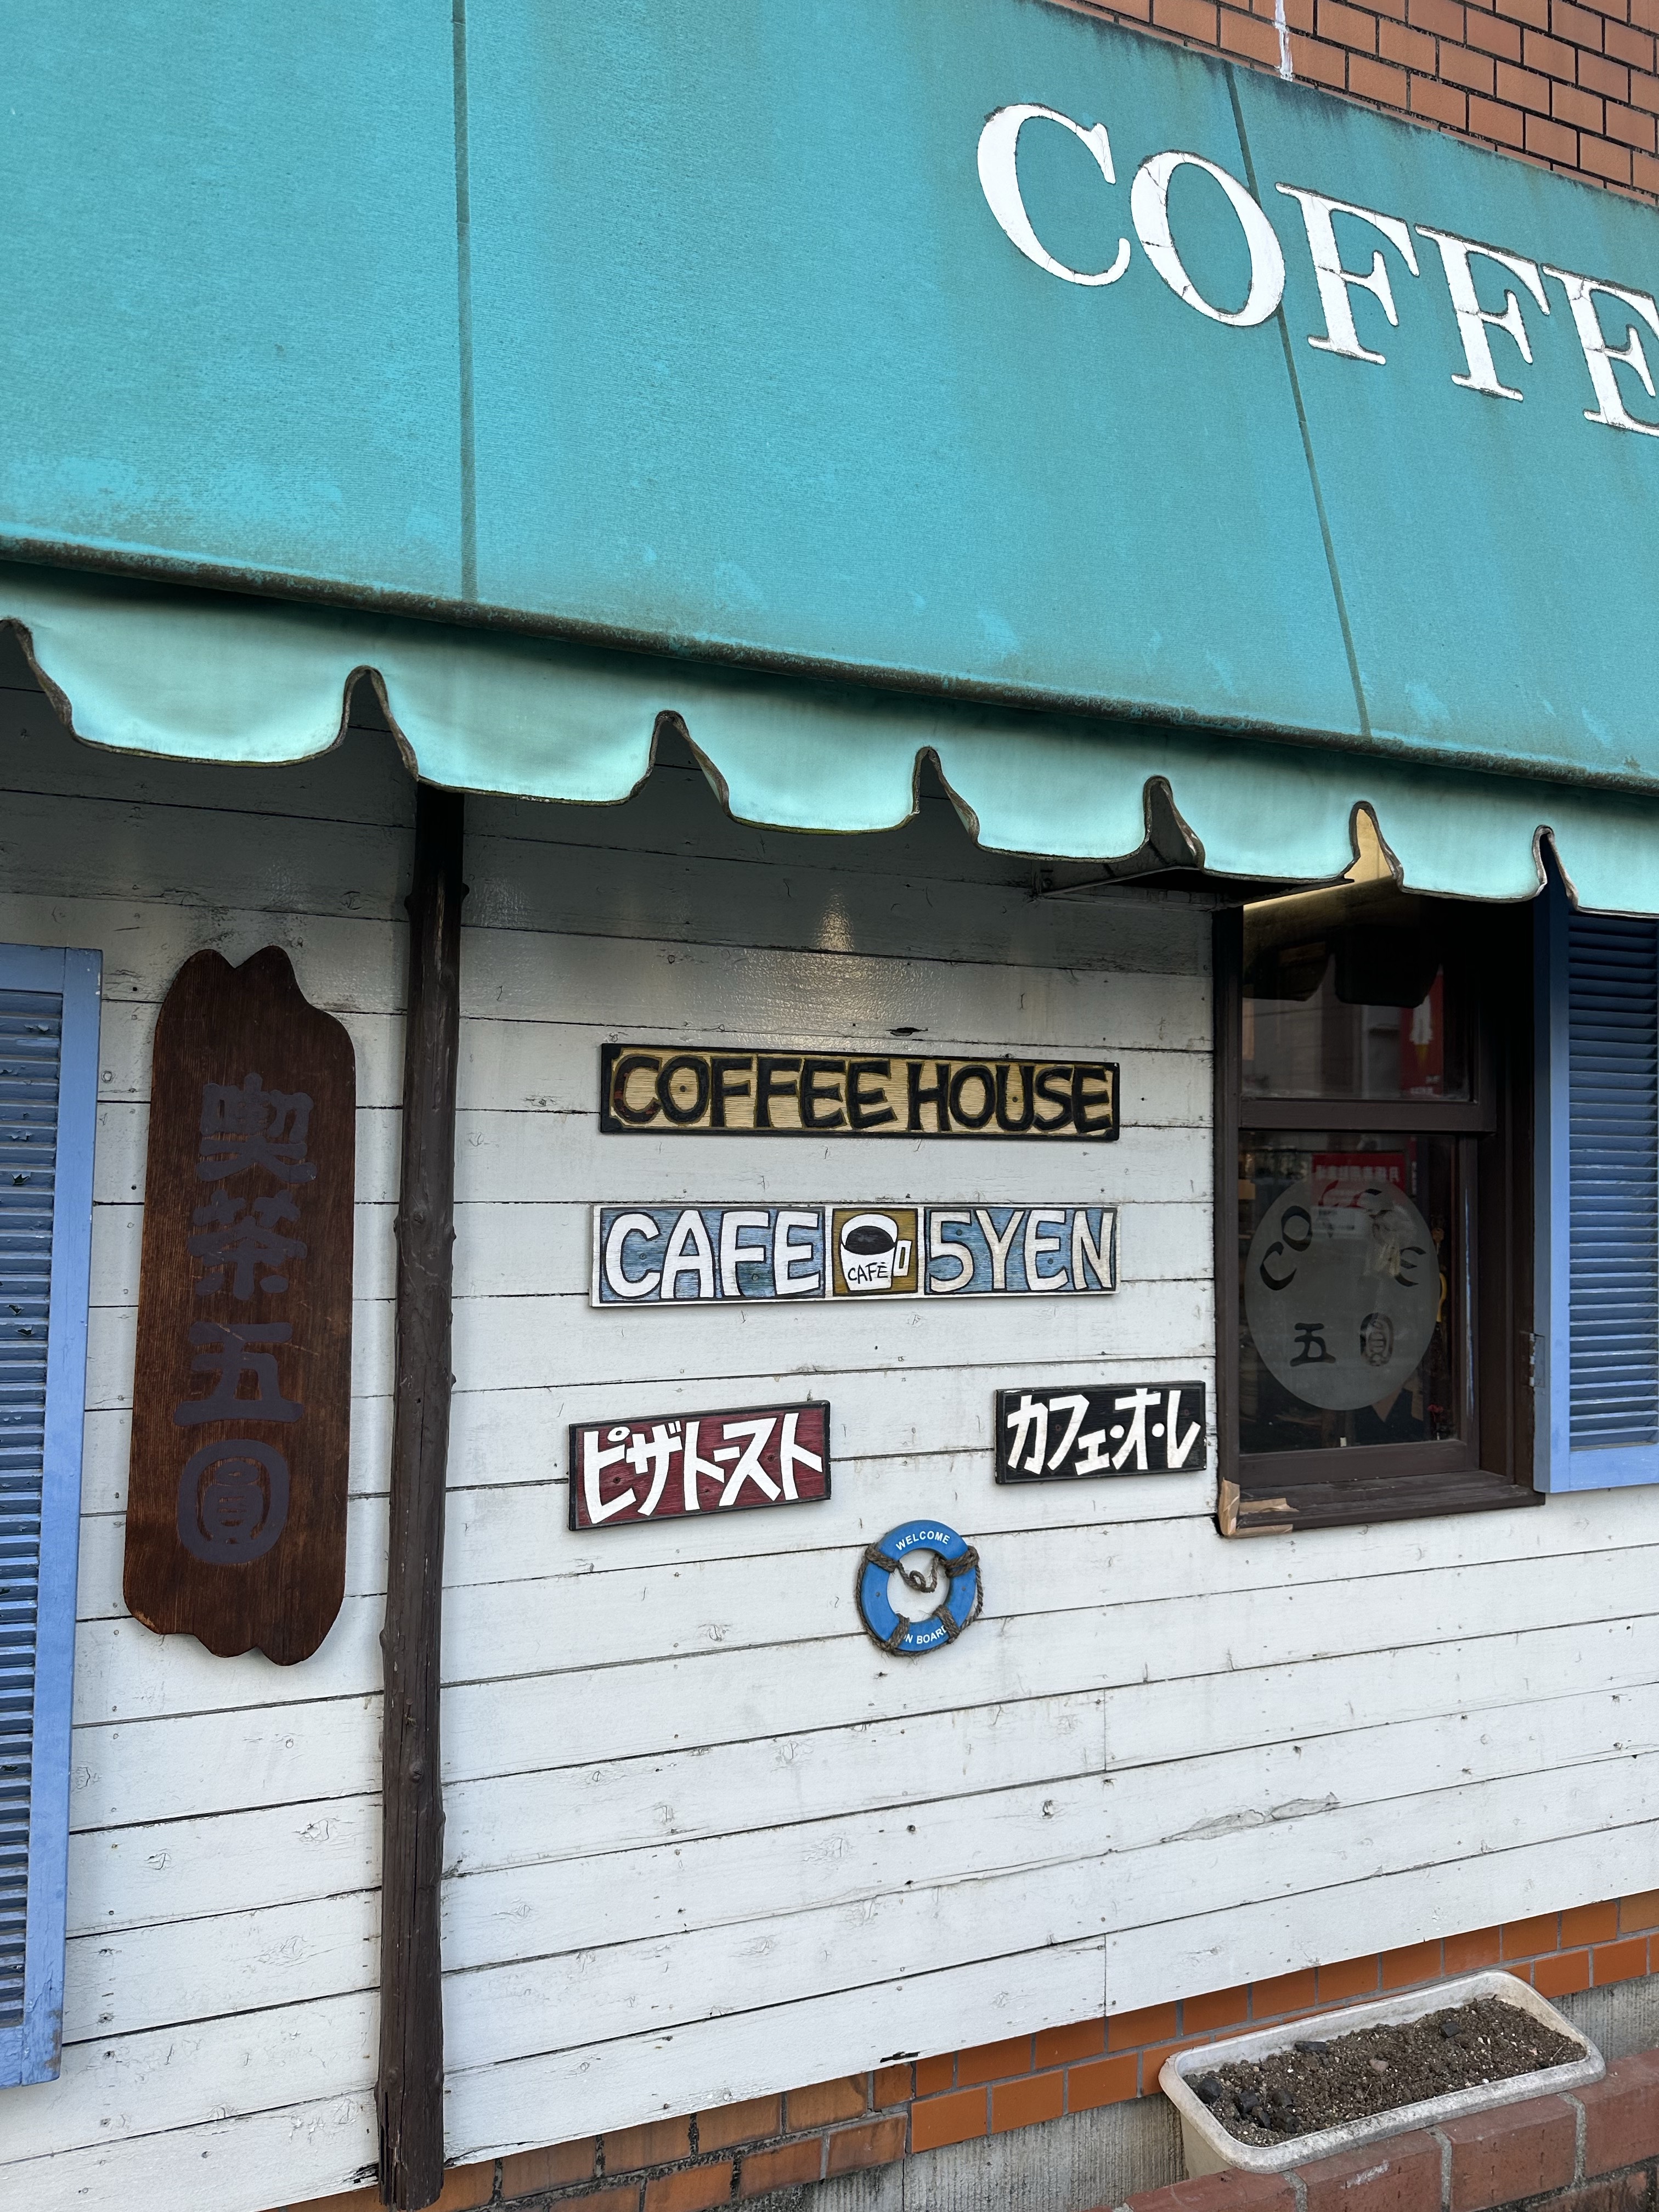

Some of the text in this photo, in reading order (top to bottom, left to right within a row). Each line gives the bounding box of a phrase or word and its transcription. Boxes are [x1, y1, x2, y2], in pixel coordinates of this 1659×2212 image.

[612, 1054, 1114, 1134] COFFEE HOUSE
[602, 1209, 823, 1299] CAFE
[583, 1412, 823, 1524] ピザトースト
[895, 1530, 950, 1551] WELCOME
[902, 1634, 913, 1644] N
